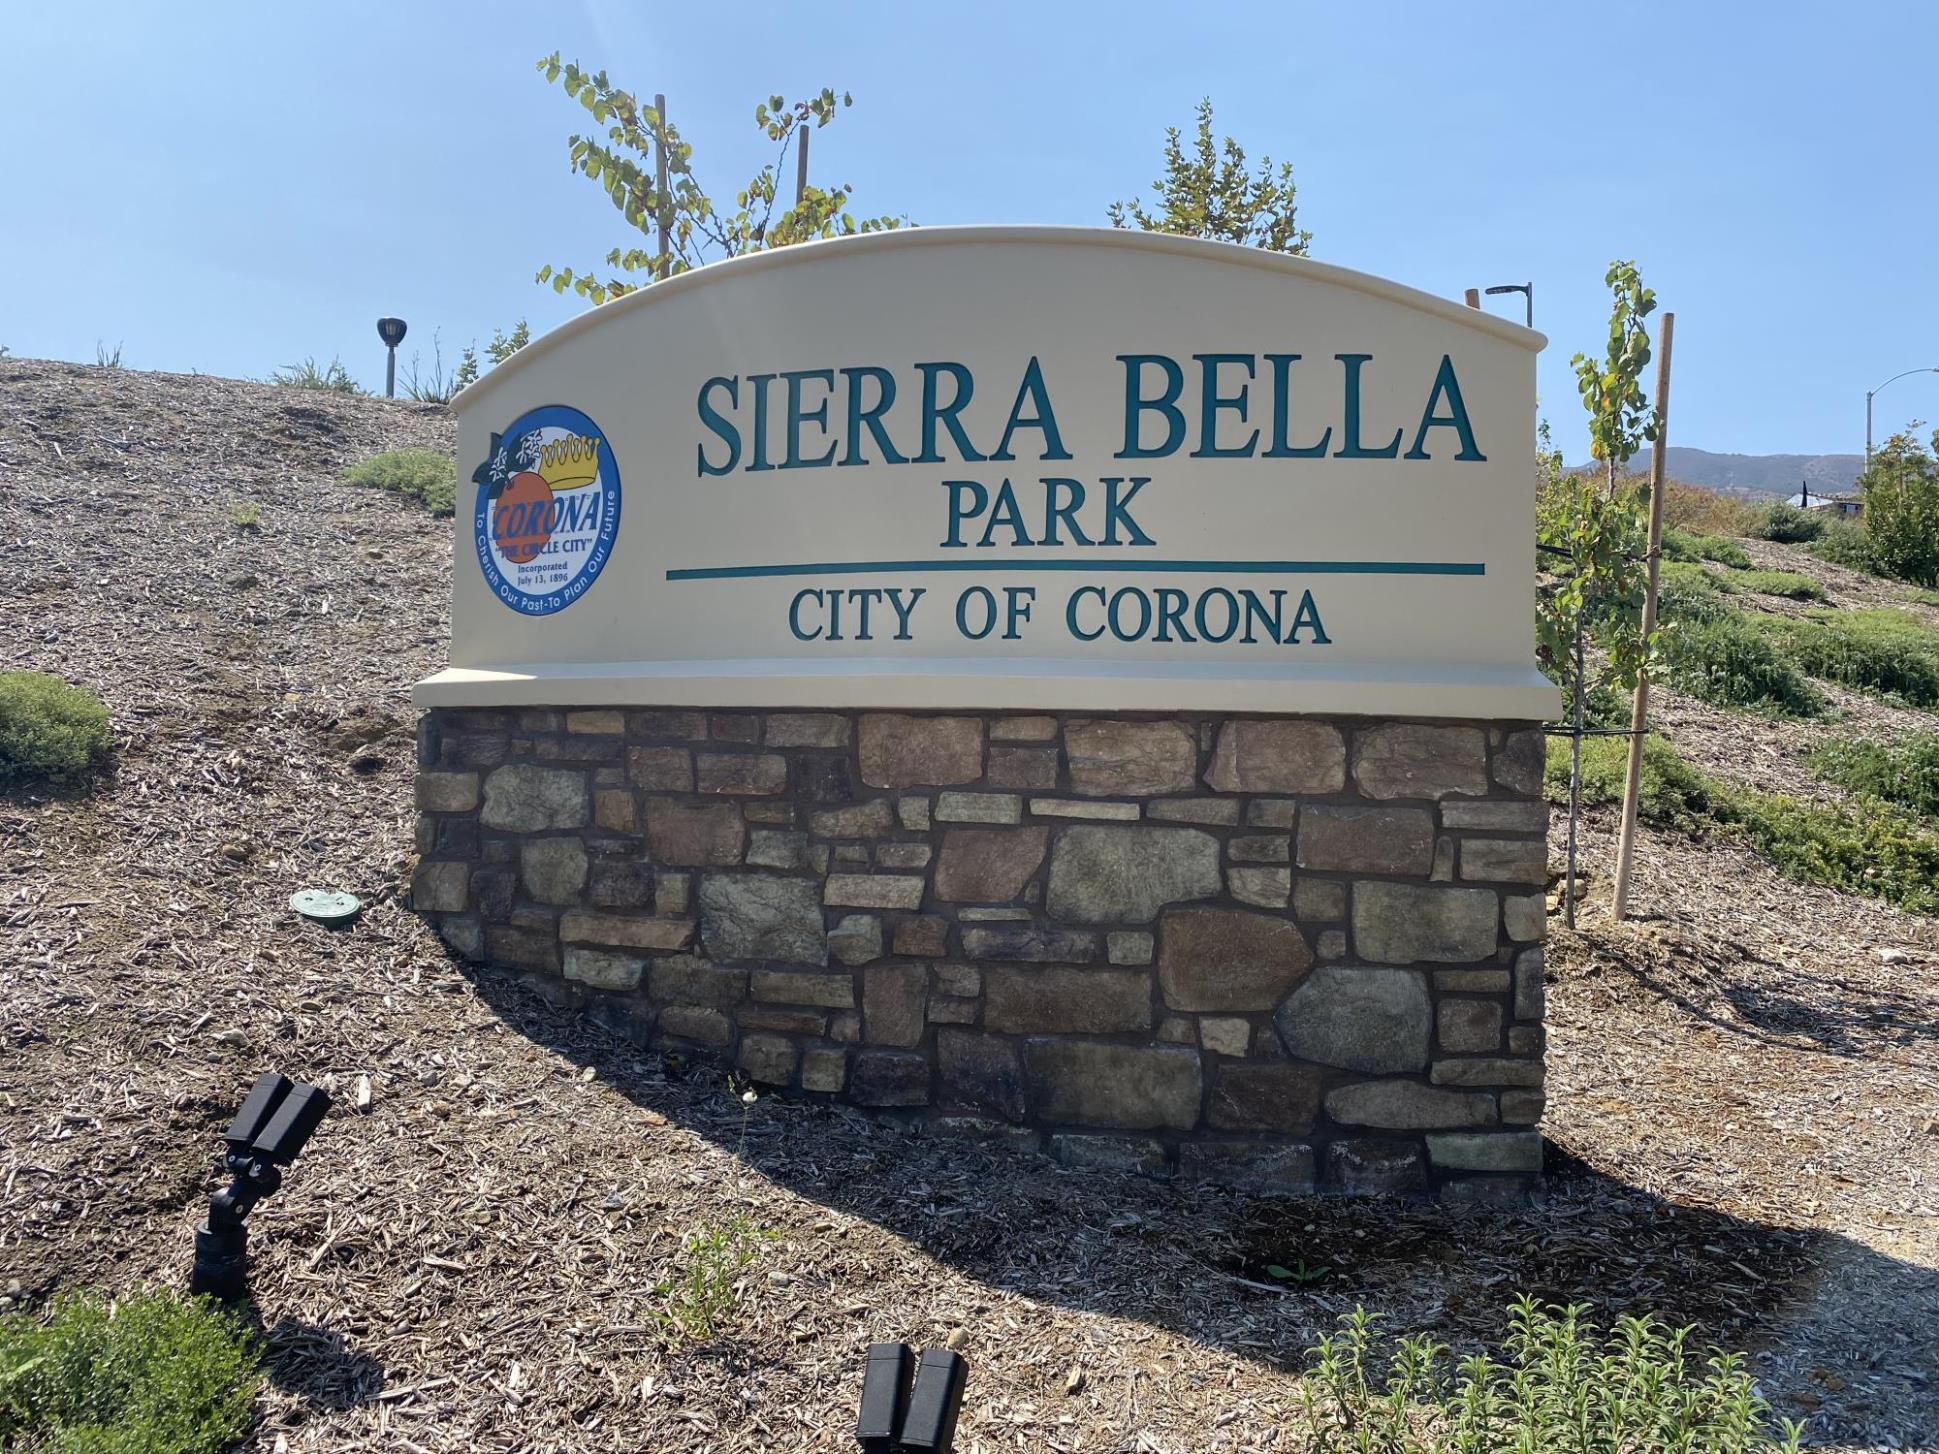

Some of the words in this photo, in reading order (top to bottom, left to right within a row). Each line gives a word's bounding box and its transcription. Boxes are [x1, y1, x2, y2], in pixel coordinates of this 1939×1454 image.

[697, 356, 1073, 478] SIERRA
[1113, 354, 1487, 461] BELLA
[477, 512, 485, 529] To
[492, 491, 601, 541] CORONA
[600, 490, 615, 541] Future
[940, 477, 1157, 548] PARK
[478, 535, 499, 586] Cherish
[518, 562, 568, 574] Incorporated
[587, 547, 605, 574] Our
[500, 585, 519, 604] Our
[517, 575, 532, 587] July
[535, 575, 546, 585] 13,
[549, 573, 568, 583] 1896
[563, 577, 588, 601] Plan
[788, 588, 926, 641] CITY
[955, 586, 1036, 641] OF
[1066, 586, 1332, 645] CORONA
